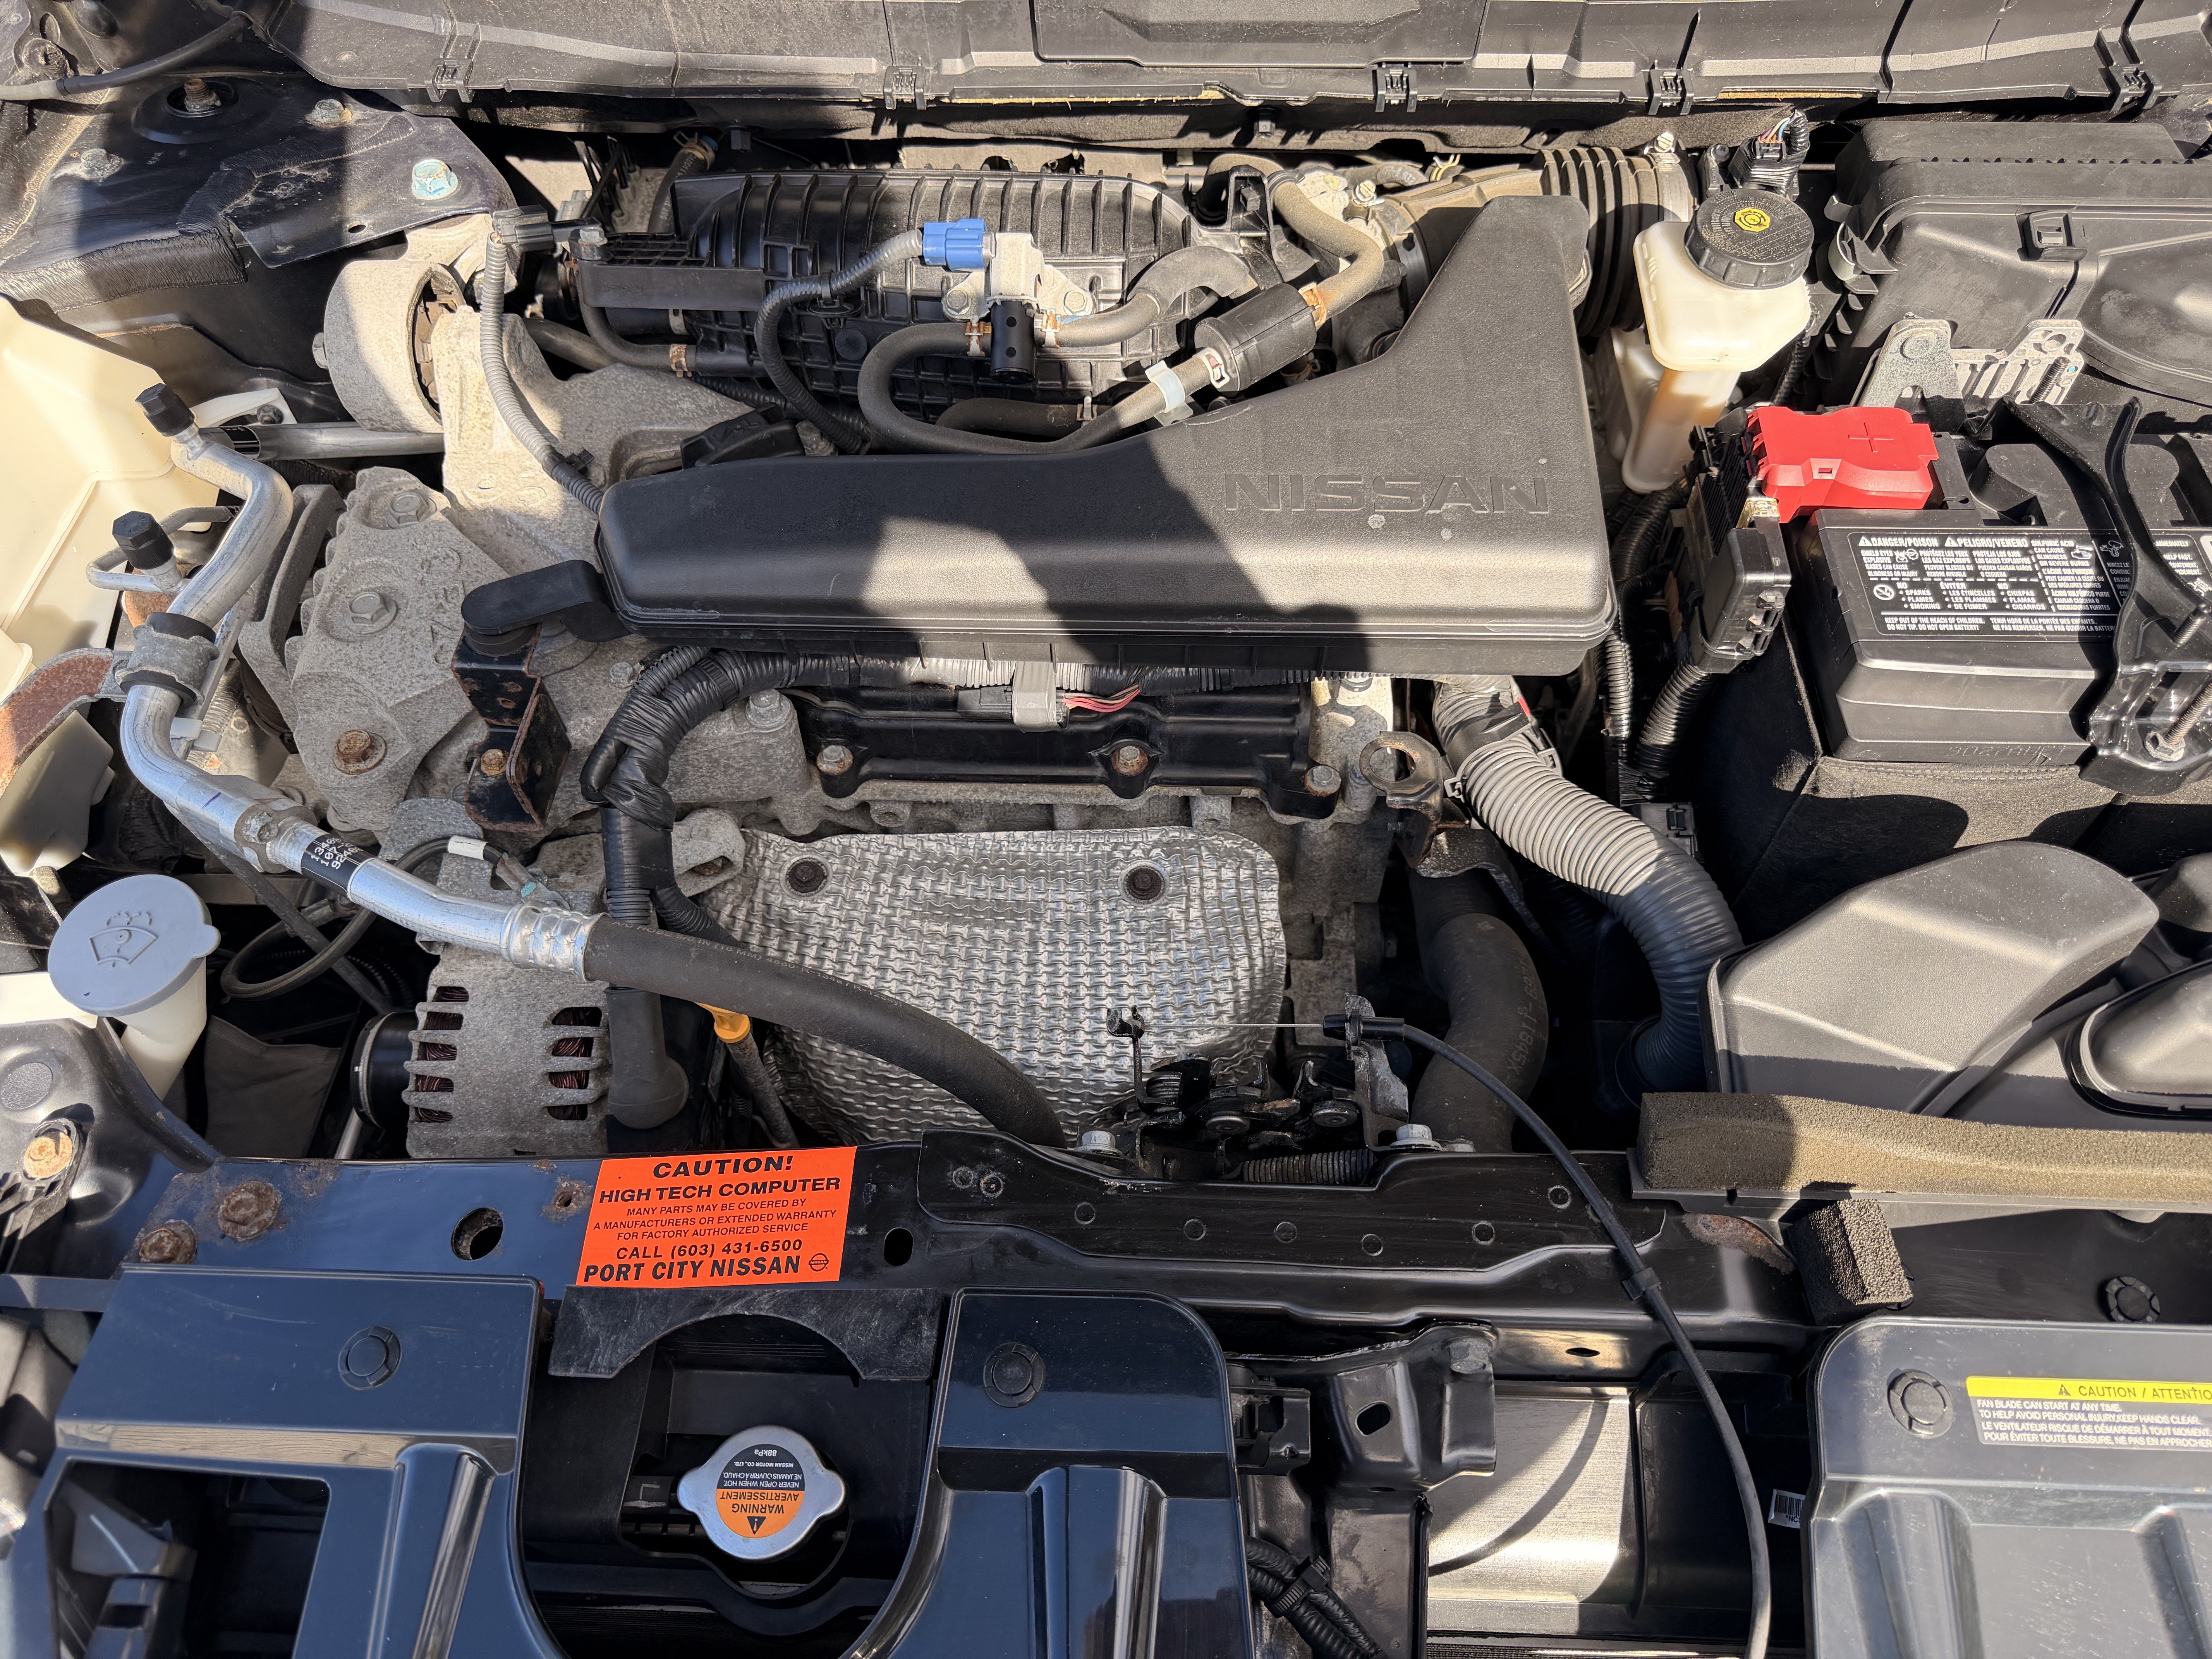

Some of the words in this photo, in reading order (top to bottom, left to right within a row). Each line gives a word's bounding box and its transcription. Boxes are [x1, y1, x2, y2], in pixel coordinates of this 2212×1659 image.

[1225, 474, 1550, 514] NISSAN
[1870, 538, 1939, 547] DANGER/POISON
[1957, 538, 2028, 548] PELIGRO/VENENO
[653, 1155, 793, 1178] CAUTION!
[599, 1188, 651, 1204] HIGH
[658, 1185, 712, 1200] TECH
[719, 1177, 840, 1197] COMPUTER
[627, 1207, 658, 1216] MANY
[659, 1205, 693, 1214] PARTS
[696, 1204, 719, 1212] MAY
[721, 1202, 735, 1211] BE
[738, 1200, 789, 1210] COVERED
[792, 1199, 806, 1207] BY
[593, 1221, 600, 1230] A
[603, 1218, 696, 1230] MANUFACTURERS
[699, 1216, 714, 1224] OR
[717, 1213, 774, 1224] EXTENDED
[776, 1210, 837, 1221] WARRANTY
[617, 1232, 639, 1240] FOR
[641, 1229, 690, 1239] FACTORY
[692, 1225, 759, 1237] AUTHORIZED
[763, 1223, 808, 1233] SERVICE
[616, 1246, 663, 1259] CALL
[671, 1243, 716, 1260] (603)
[722, 1239, 802, 1255] 431-6500
[584, 1263, 644, 1282] PORT
[652, 1259, 704, 1280] CITY
[710, 1255, 801, 1277] NISSAN
[2078, 1385, 2136, 1398] CAUTION
[1977, 1399, 1994, 1408] FAN
[1994, 1400, 2023, 1409] BLADE
[2023, 1401, 2042, 1410] CAN
[2043, 1401, 2068, 1410] START
[2070, 1402, 2080, 1410] AT
[2082, 1402, 2099, 1411] ANY
[2100, 1403, 2122, 1412] TIME.
[1978, 1410, 1992, 1419] TO
[1992, 1410, 2015, 1419] HELP
[2016, 1411, 2041, 1420] AVOID
[2042, 1412, 2088, 1421] PERSONAL
[2139, 1414, 2170, 1424] HANDS
[2170, 1415, 2202, 1425] CLEAR.
[1982, 1421, 1993, 1430] LE
[1993, 1422, 2048, 1432] VENTILATEUR
[2048, 1424, 2080, 1433] RISQUE
[2081, 1424, 2093, 1433] DE
[2094, 1423, 2142, 1434] DÉMARRER
[2149, 1426, 2172, 1436] TOUT
[1984, 1432, 2009, 1441] POUR
[2009, 1431, 2039, 1442] ÉVITER
[2039, 1434, 2067, 1443] TOUTE
[2067, 1434, 2114, 1444] BLESSURE,
[2114, 1436, 2128, 1445] NE
[2128, 1437, 2146, 1445] PAS
[2146, 1437, 2159, 1446] EN
[720, 1491, 799, 1501] AVERTISSEMENT
[732, 1503, 784, 1514] WARNING
